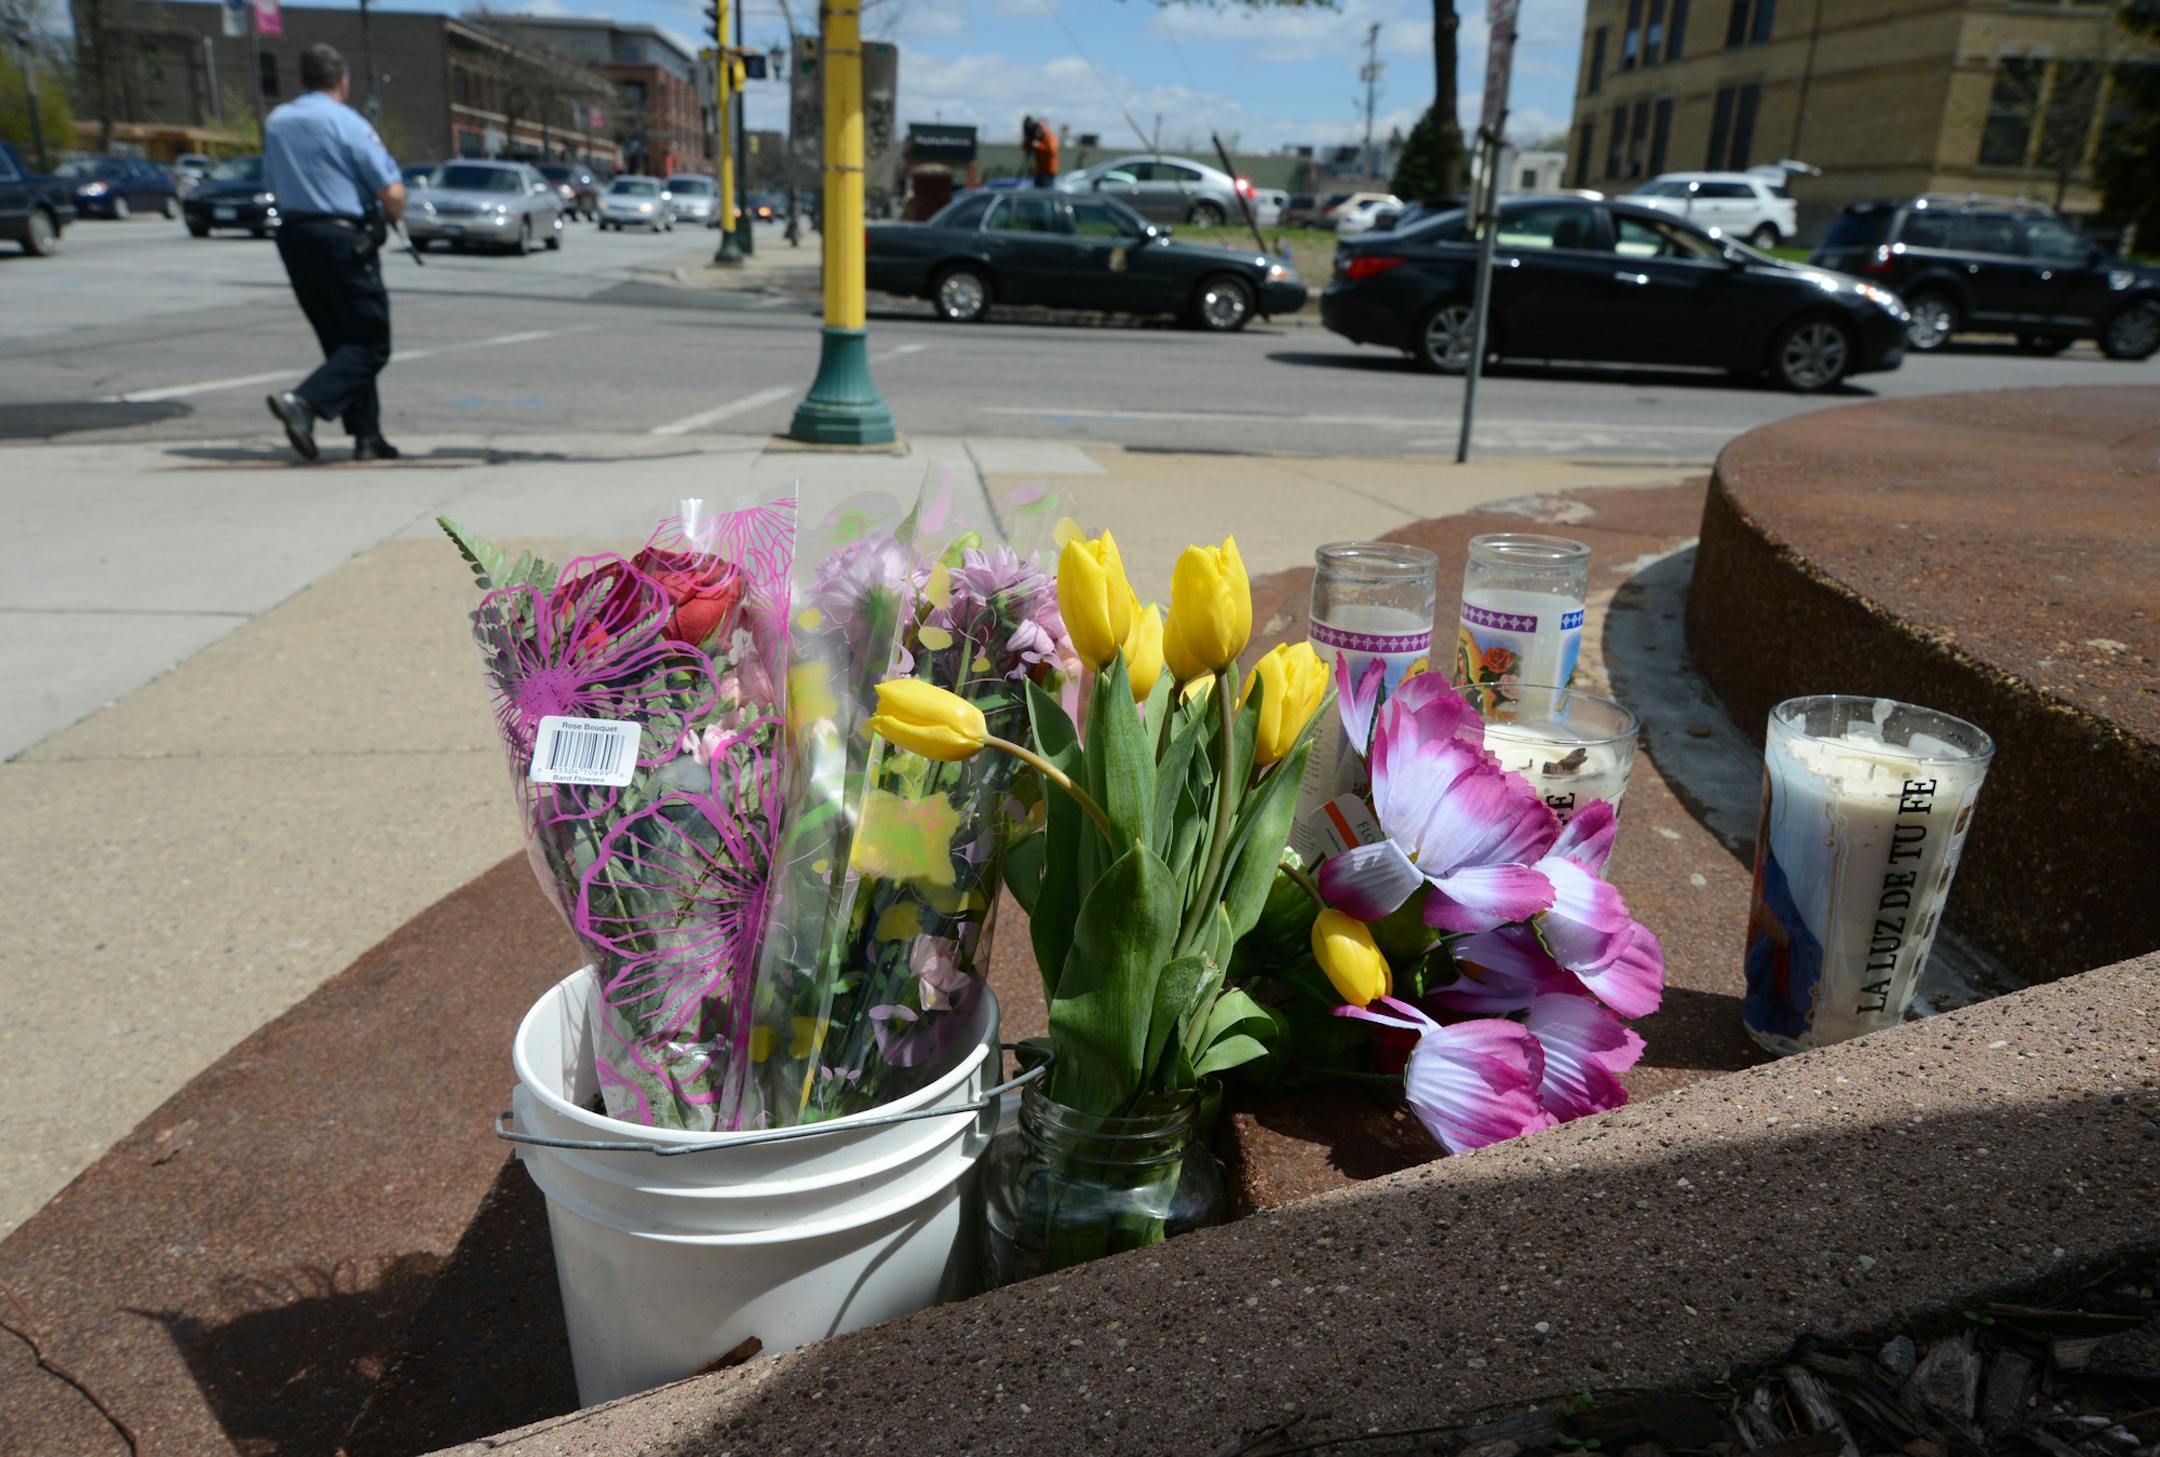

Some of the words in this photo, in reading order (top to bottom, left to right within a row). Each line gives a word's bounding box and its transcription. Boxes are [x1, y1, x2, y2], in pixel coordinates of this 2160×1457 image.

[562, 722, 582, 730] Rose
[584, 723, 618, 733] Bouquet
[573, 775, 605, 783] Flowers
[1898, 779, 1937, 815] FE
[1888, 823, 1927, 864] TU
[1878, 871, 1917, 911] DE
[1865, 917, 1906, 973] LUZ
[1856, 977, 1892, 1015] LA
